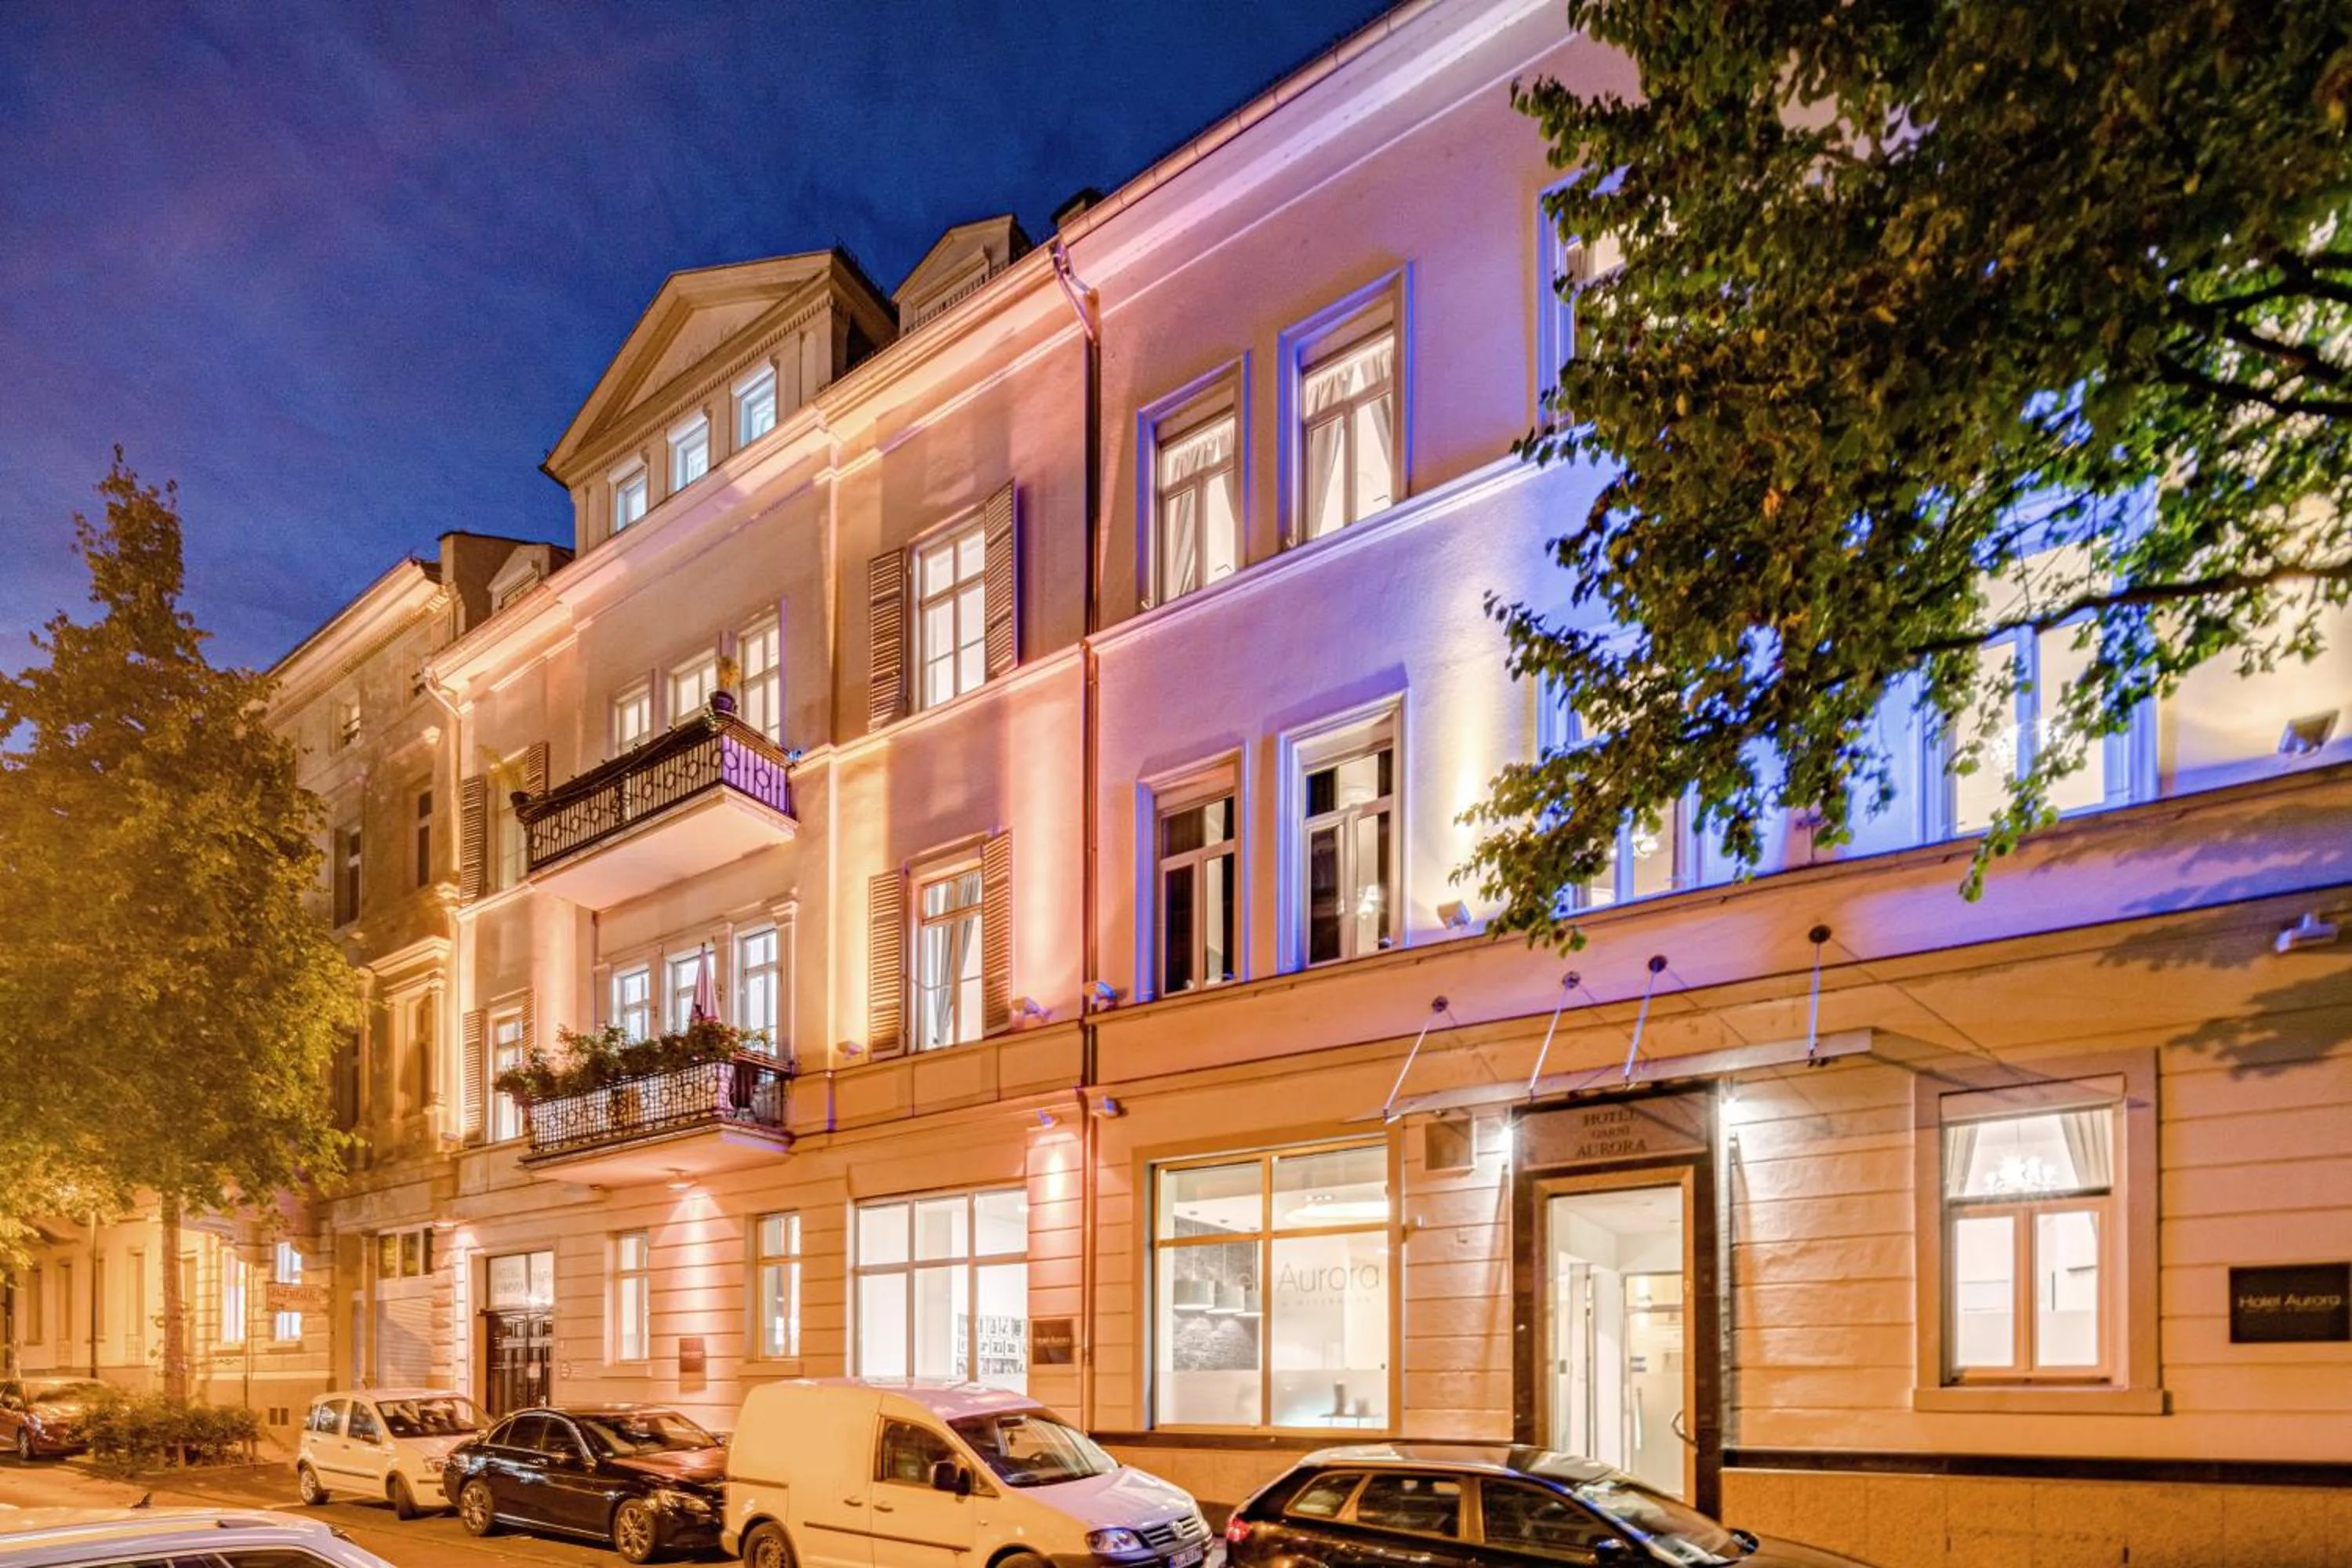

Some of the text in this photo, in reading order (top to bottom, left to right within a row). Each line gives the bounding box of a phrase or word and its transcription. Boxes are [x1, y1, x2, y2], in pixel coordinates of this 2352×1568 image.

[1584, 1107, 1637, 1126] HOTEL
[1577, 1138, 1647, 1157] AURORA
[1276, 1263, 1380, 1294] Aurora
[2238, 1293, 2342, 1308] Hotel Aurora
